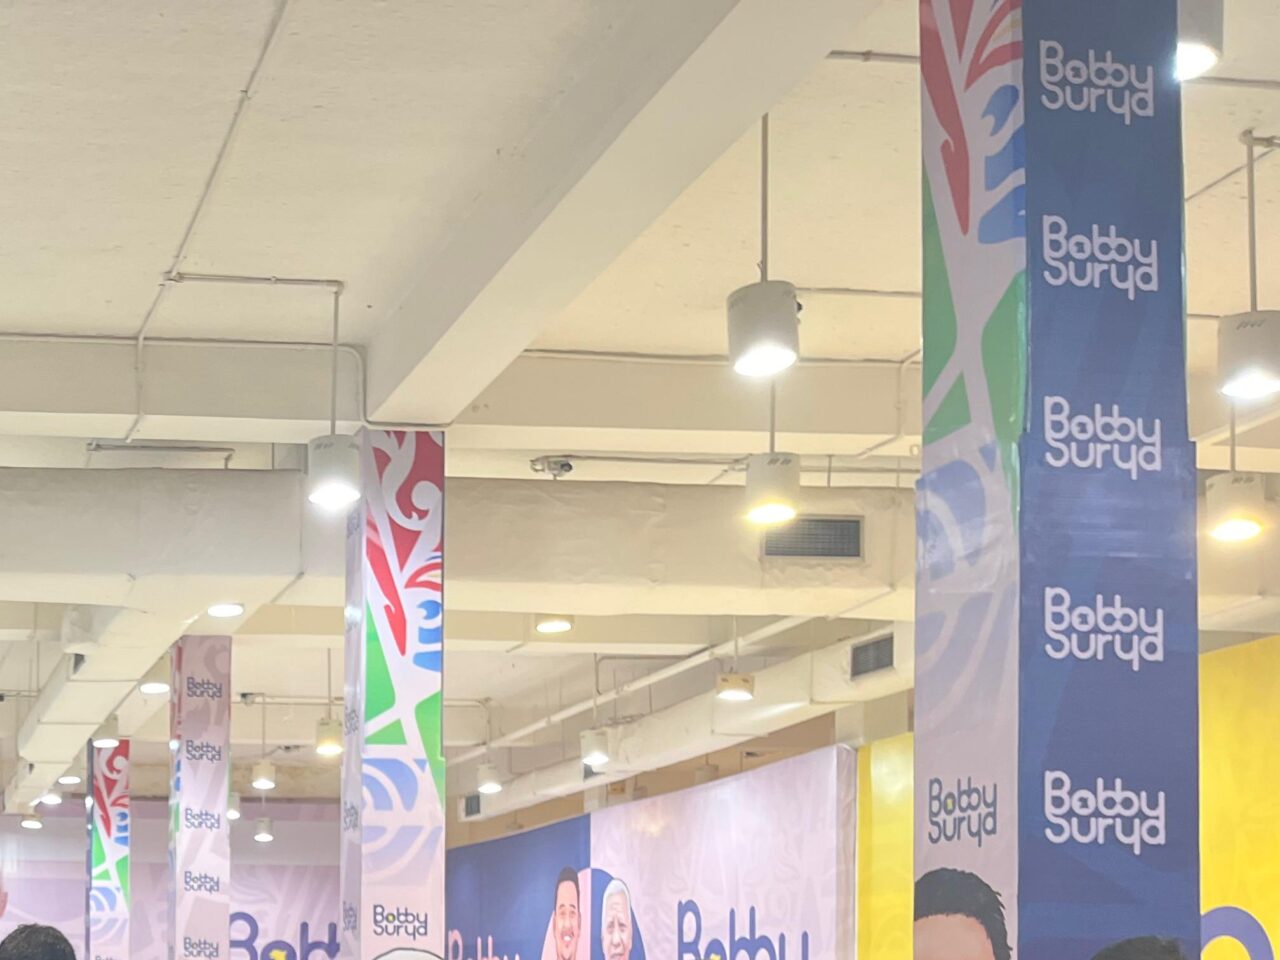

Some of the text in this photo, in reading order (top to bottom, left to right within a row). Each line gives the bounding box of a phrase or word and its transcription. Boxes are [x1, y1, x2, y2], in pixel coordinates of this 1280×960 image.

[1039, 40, 1154, 88] Bobby
[1042, 215, 1158, 263] Bobby
[1044, 396, 1161, 443] Bobby
[1044, 586, 1164, 634] Bobby
[186, 677, 223, 690] Bobby
[185, 740, 222, 753] Bobby
[928, 777, 998, 815] Bobby
[1044, 771, 1166, 818] Bobby
[184, 808, 220, 821] Bobby
[184, 871, 220, 884] Bobby
[373, 904, 428, 924] Bobby
[183, 937, 219, 950] Bobby
